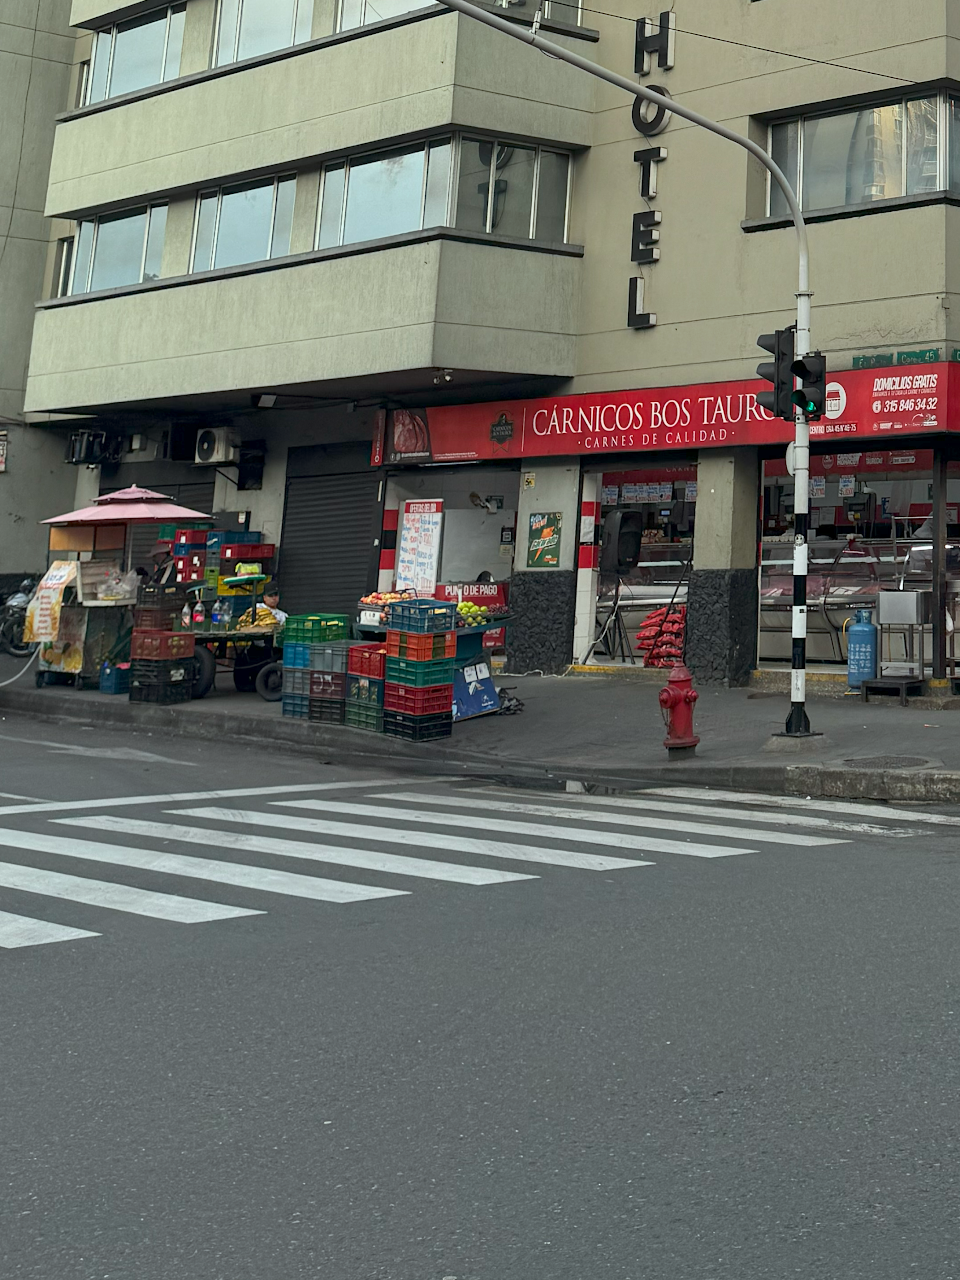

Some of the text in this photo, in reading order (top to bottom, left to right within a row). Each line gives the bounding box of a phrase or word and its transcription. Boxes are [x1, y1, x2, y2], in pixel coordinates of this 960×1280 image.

[627, 10, 677, 330] HOTEL
[924, 351, 935, 362] 45
[873, 374, 938, 391] DOMICILIOS GRATIS
[884, 397, 938, 412] 315 846 34 32
[532, 402, 644, 436] CÁRNICOS
[650, 398, 690, 430] BOS
[698, 393, 783, 425] TAUR
[584, 428, 728, 449] CARNES DE CALIDAD
[445, 584, 498, 596] PUNO DE PAGO
